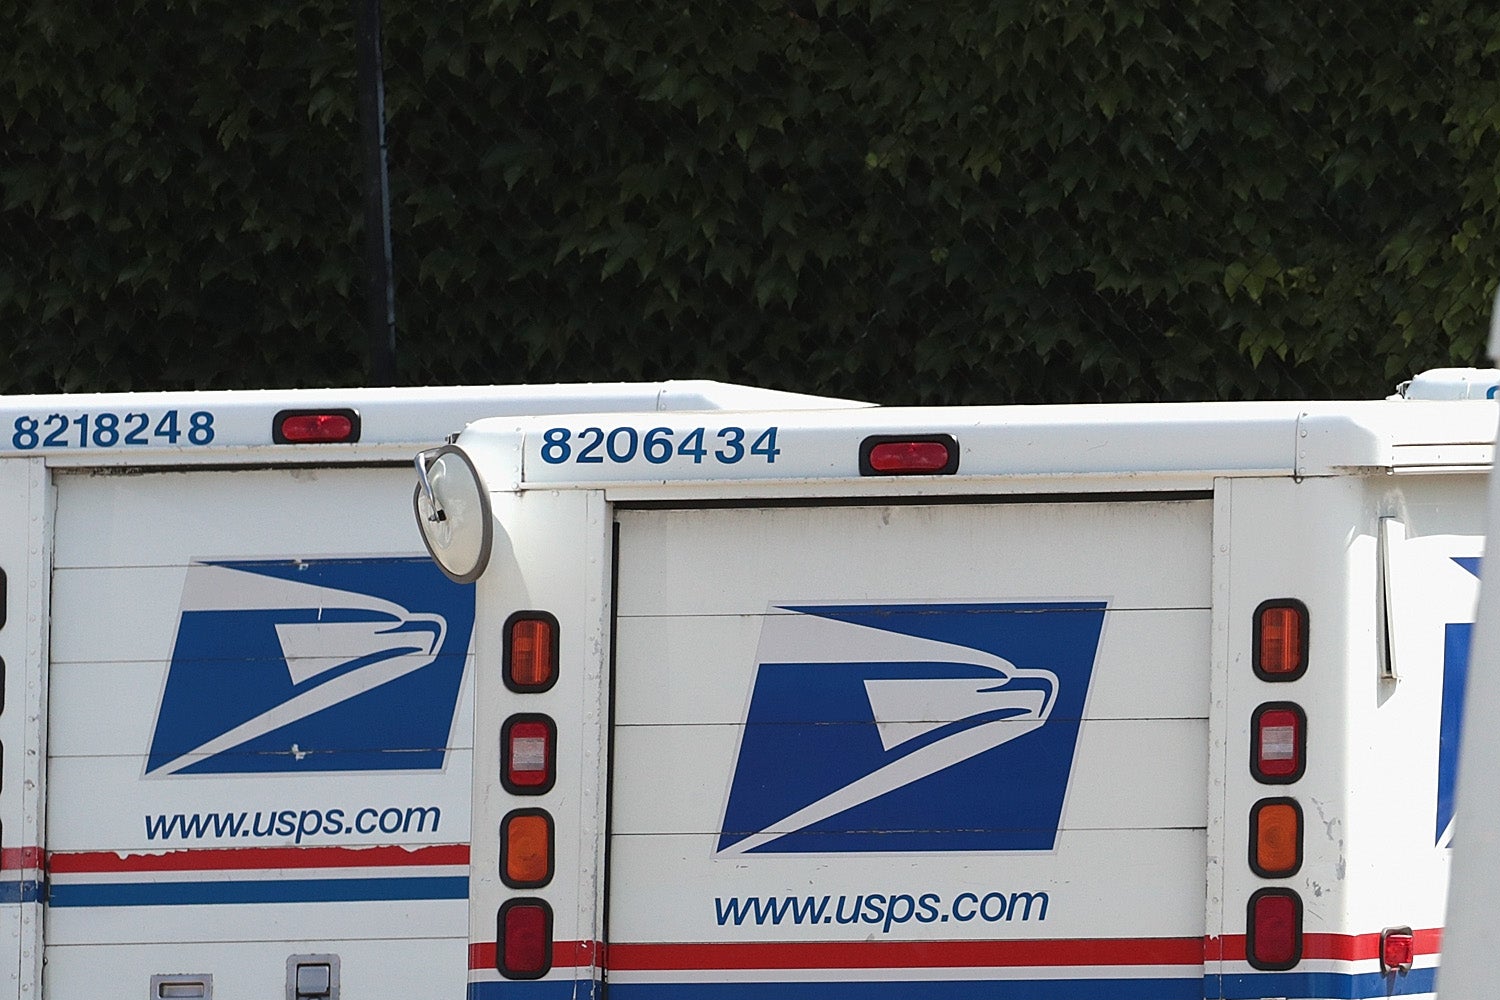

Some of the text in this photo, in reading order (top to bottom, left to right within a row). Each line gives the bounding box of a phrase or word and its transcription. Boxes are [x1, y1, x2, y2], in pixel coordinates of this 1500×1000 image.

[12, 409, 215, 450] 8218248
[541, 426, 781, 465] 8206434
[145, 806, 441, 844] www.usps.com
[715, 891, 1049, 932] www.usps.com
